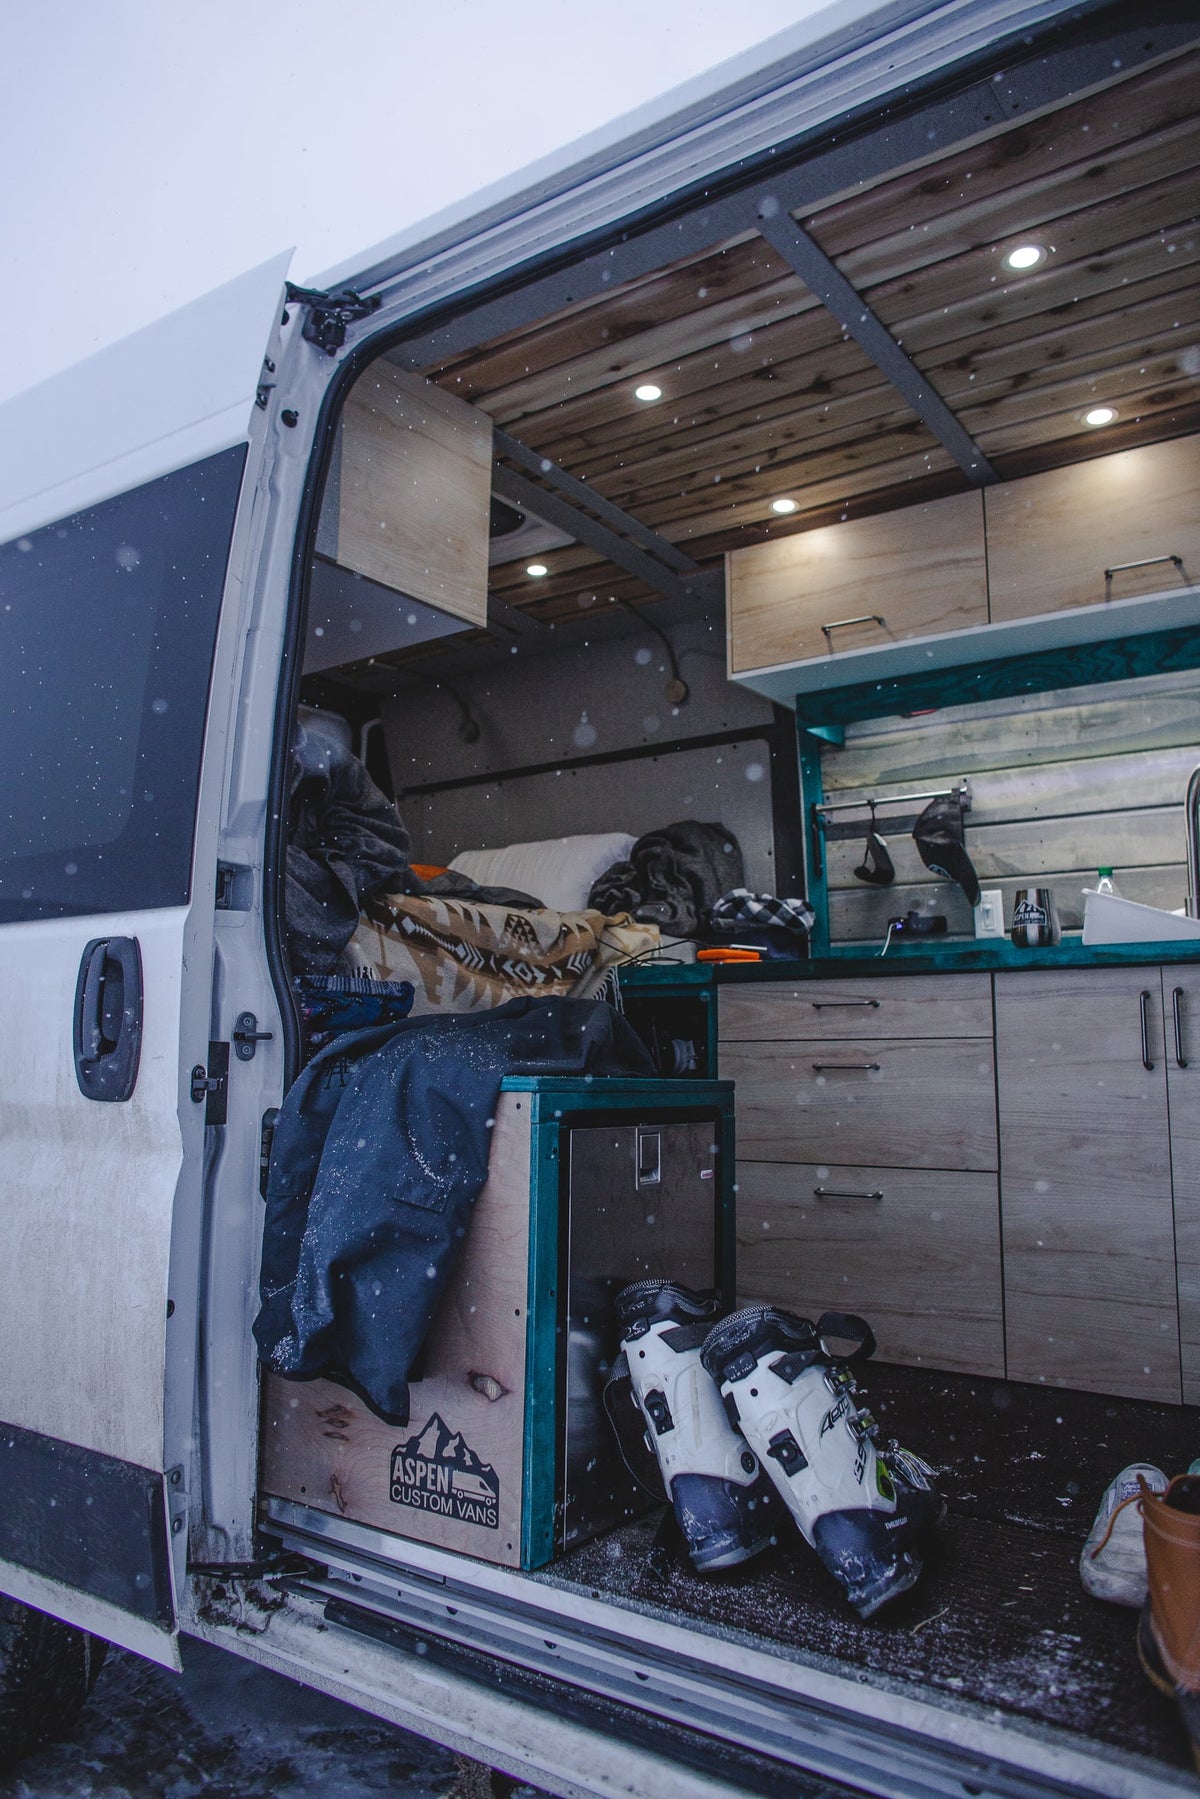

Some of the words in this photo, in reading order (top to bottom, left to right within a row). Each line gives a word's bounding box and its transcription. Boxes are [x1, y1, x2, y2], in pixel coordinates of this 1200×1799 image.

[391, 1455, 449, 1494] ASPEN
[391, 1484, 453, 1515] CUSTOM
[456, 1500, 497, 1526] VANS
